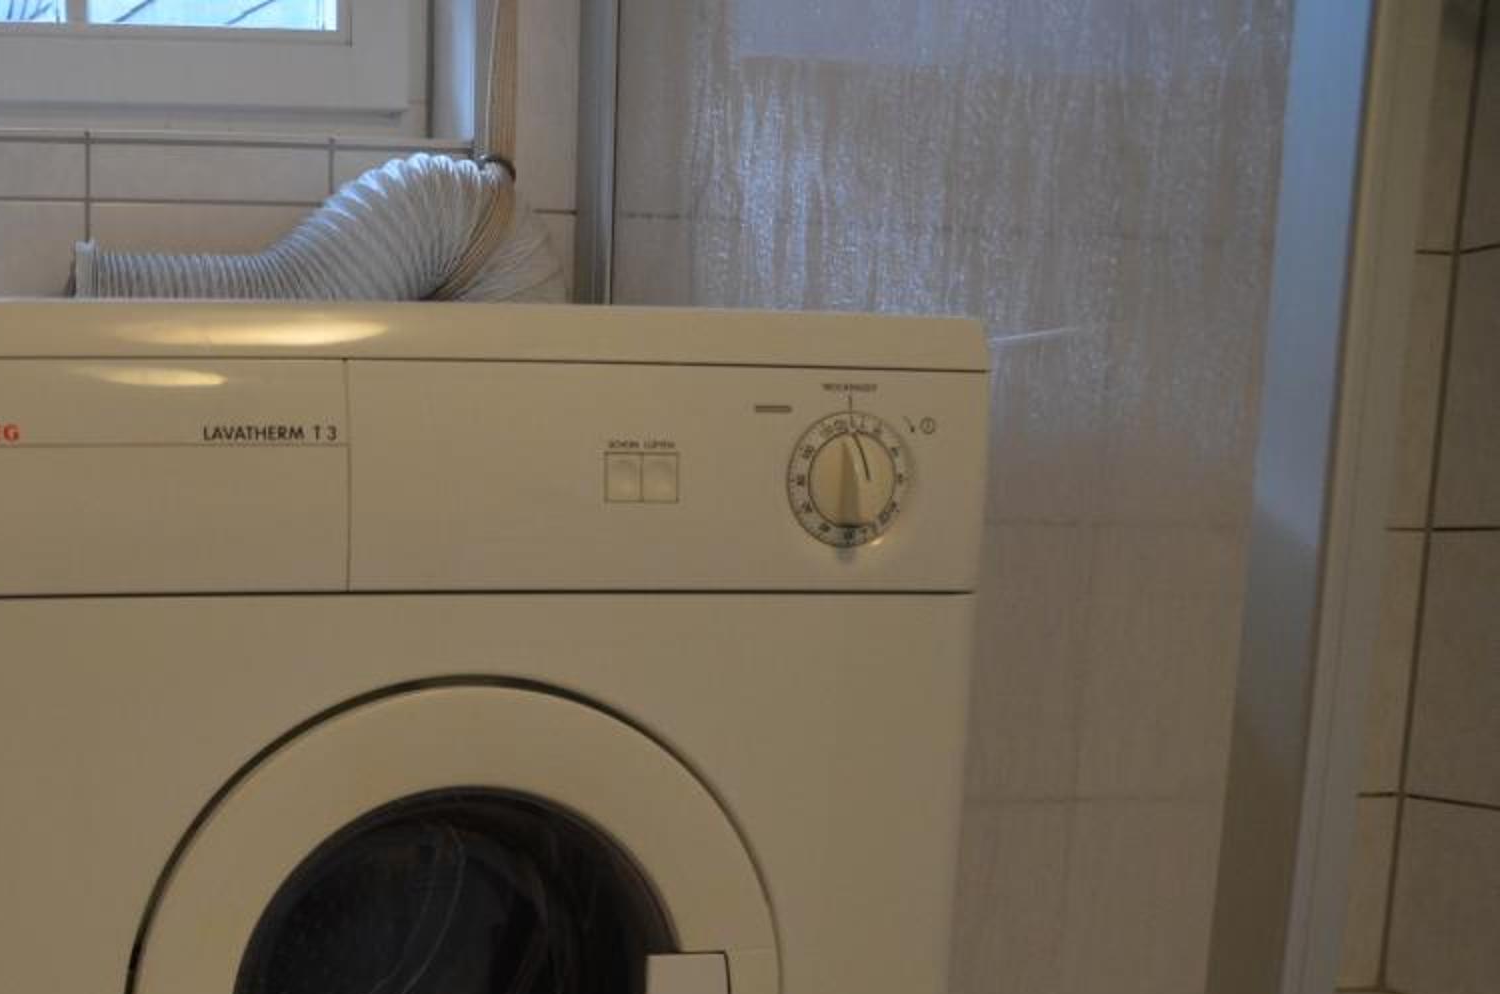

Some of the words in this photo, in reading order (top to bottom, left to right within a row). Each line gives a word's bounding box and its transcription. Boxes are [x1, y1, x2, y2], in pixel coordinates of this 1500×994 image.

[202, 423, 305, 442] LAVATHERM
[312, 424, 324, 441] T
[327, 424, 339, 441] 3
